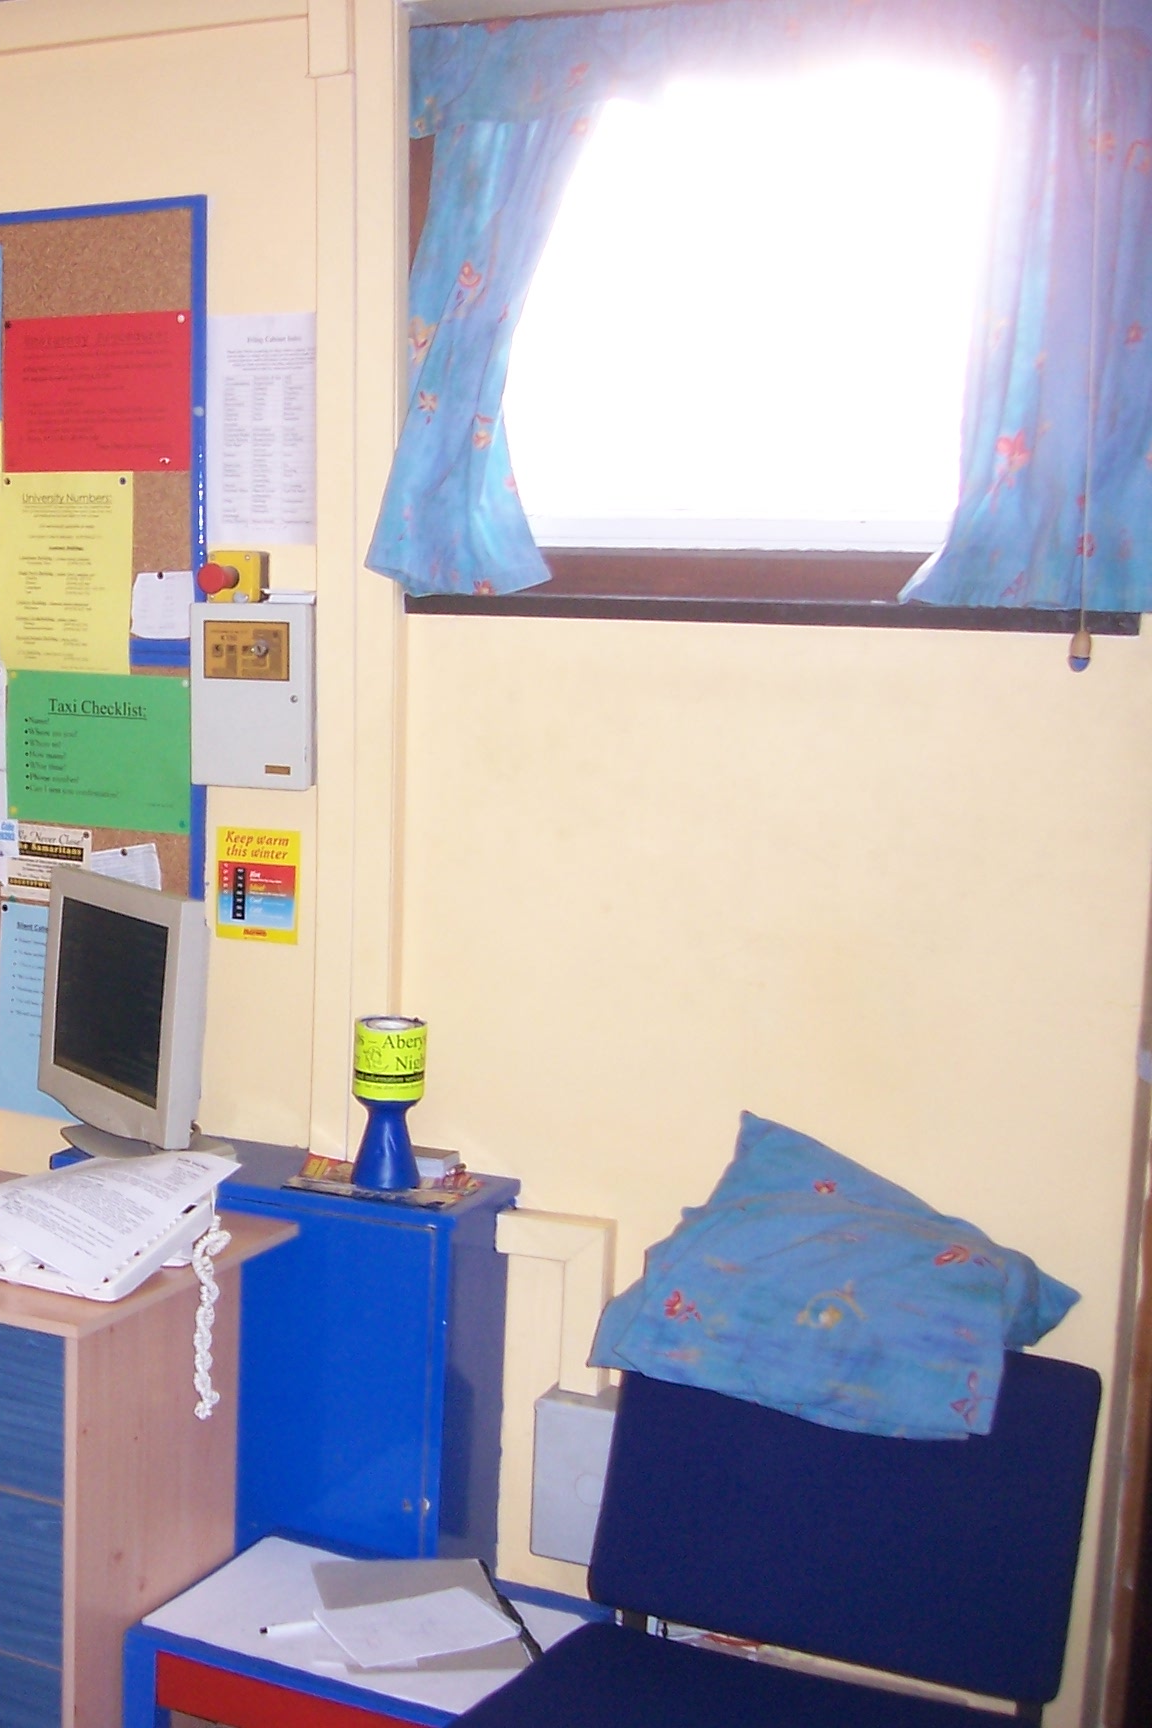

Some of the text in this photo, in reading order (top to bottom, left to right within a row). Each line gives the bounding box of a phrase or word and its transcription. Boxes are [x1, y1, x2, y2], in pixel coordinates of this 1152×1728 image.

[22, 493, 65, 504] University
[48, 698, 147, 718] Taxi Checklist:
[30, 831, 56, 843] Never
[225, 830, 290, 847] Keep warm
[31, 843, 82, 855] Samaritans
[227, 844, 288, 860] this winter
